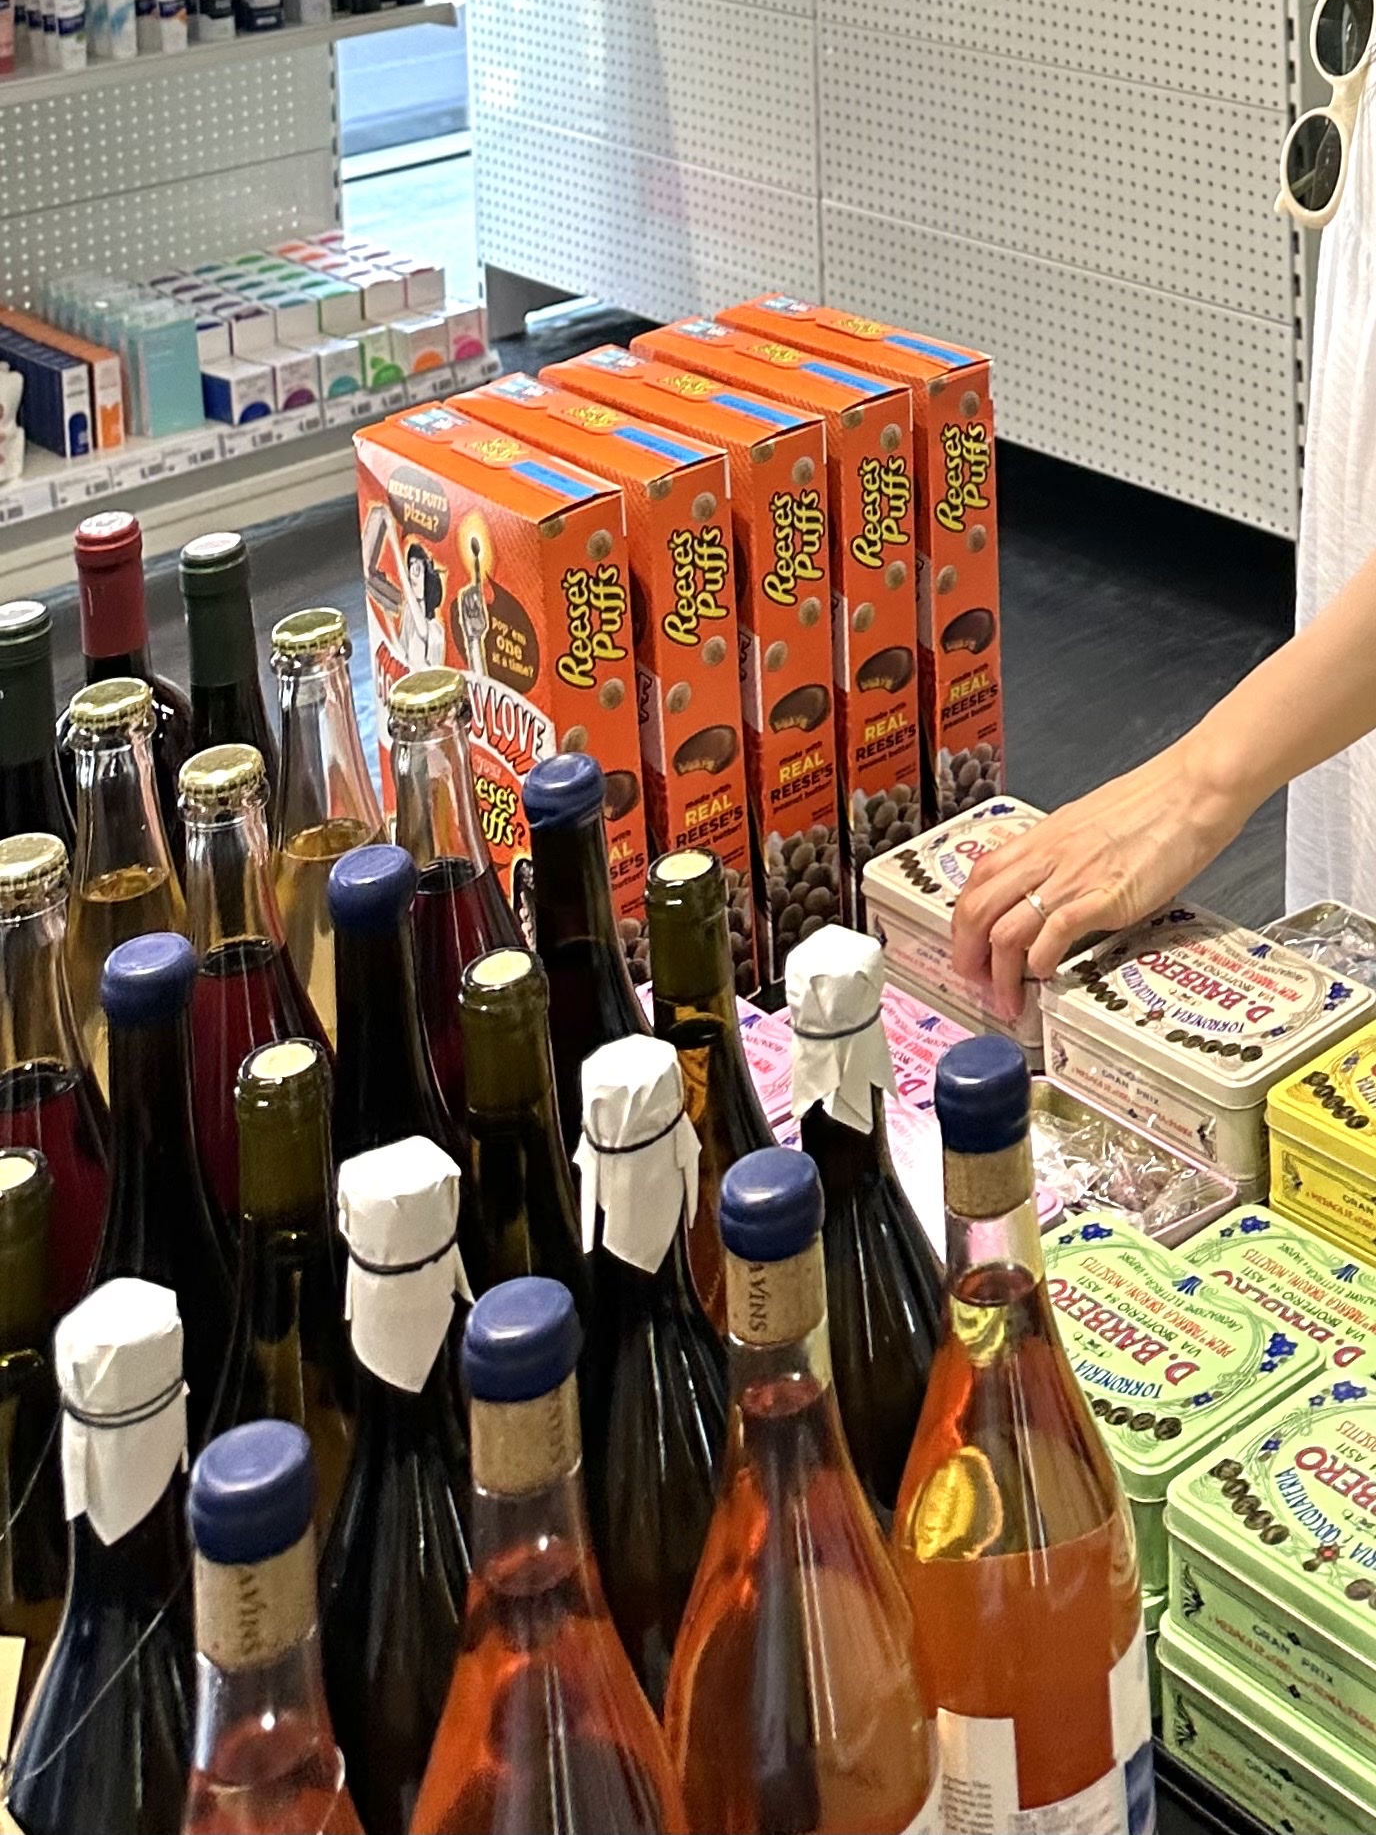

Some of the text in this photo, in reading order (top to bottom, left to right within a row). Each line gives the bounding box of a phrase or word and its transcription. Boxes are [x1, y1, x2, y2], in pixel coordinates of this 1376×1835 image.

[935, 424, 966, 532] Reese's
[962, 422, 991, 511] Puffs
[403, 501, 439, 533] pizza?
[851, 457, 884, 569] Reese's
[880, 456, 911, 545] Puffs
[763, 491, 798, 606] Reese's
[794, 489, 826, 581] Puffs
[663, 529, 700, 647] Reese's
[696, 526, 730, 620] Puffs
[557, 568, 595, 689] Reese's
[593, 564, 627, 661] Puffs
[496, 635, 523, 660] one
[941, 684, 998, 721] REESE'S
[950, 674, 990, 701] REAL
[485, 685, 547, 764] LOVE
[856, 724, 916, 762] REESE'S
[864, 713, 908, 742] REAL
[770, 763, 834, 804] REESE'S
[779, 752, 824, 783] REAL
[473, 774, 519, 815] ese's
[685, 795, 733, 827] REAL
[676, 805, 743, 848] REESE'S
[608, 841, 635, 864] AL
[609, 852, 645, 880] SE'S
[1075, 1275, 1104, 1291] ASTI
[1239, 1266, 1267, 1282] ASTI
[1179, 1340, 1202, 1357] VIA
[1344, 1326, 1366, 1342] VIA
[1333, 1337, 1367, 1370] D.
[1334, 1441, 1367, 1461] ASTI
